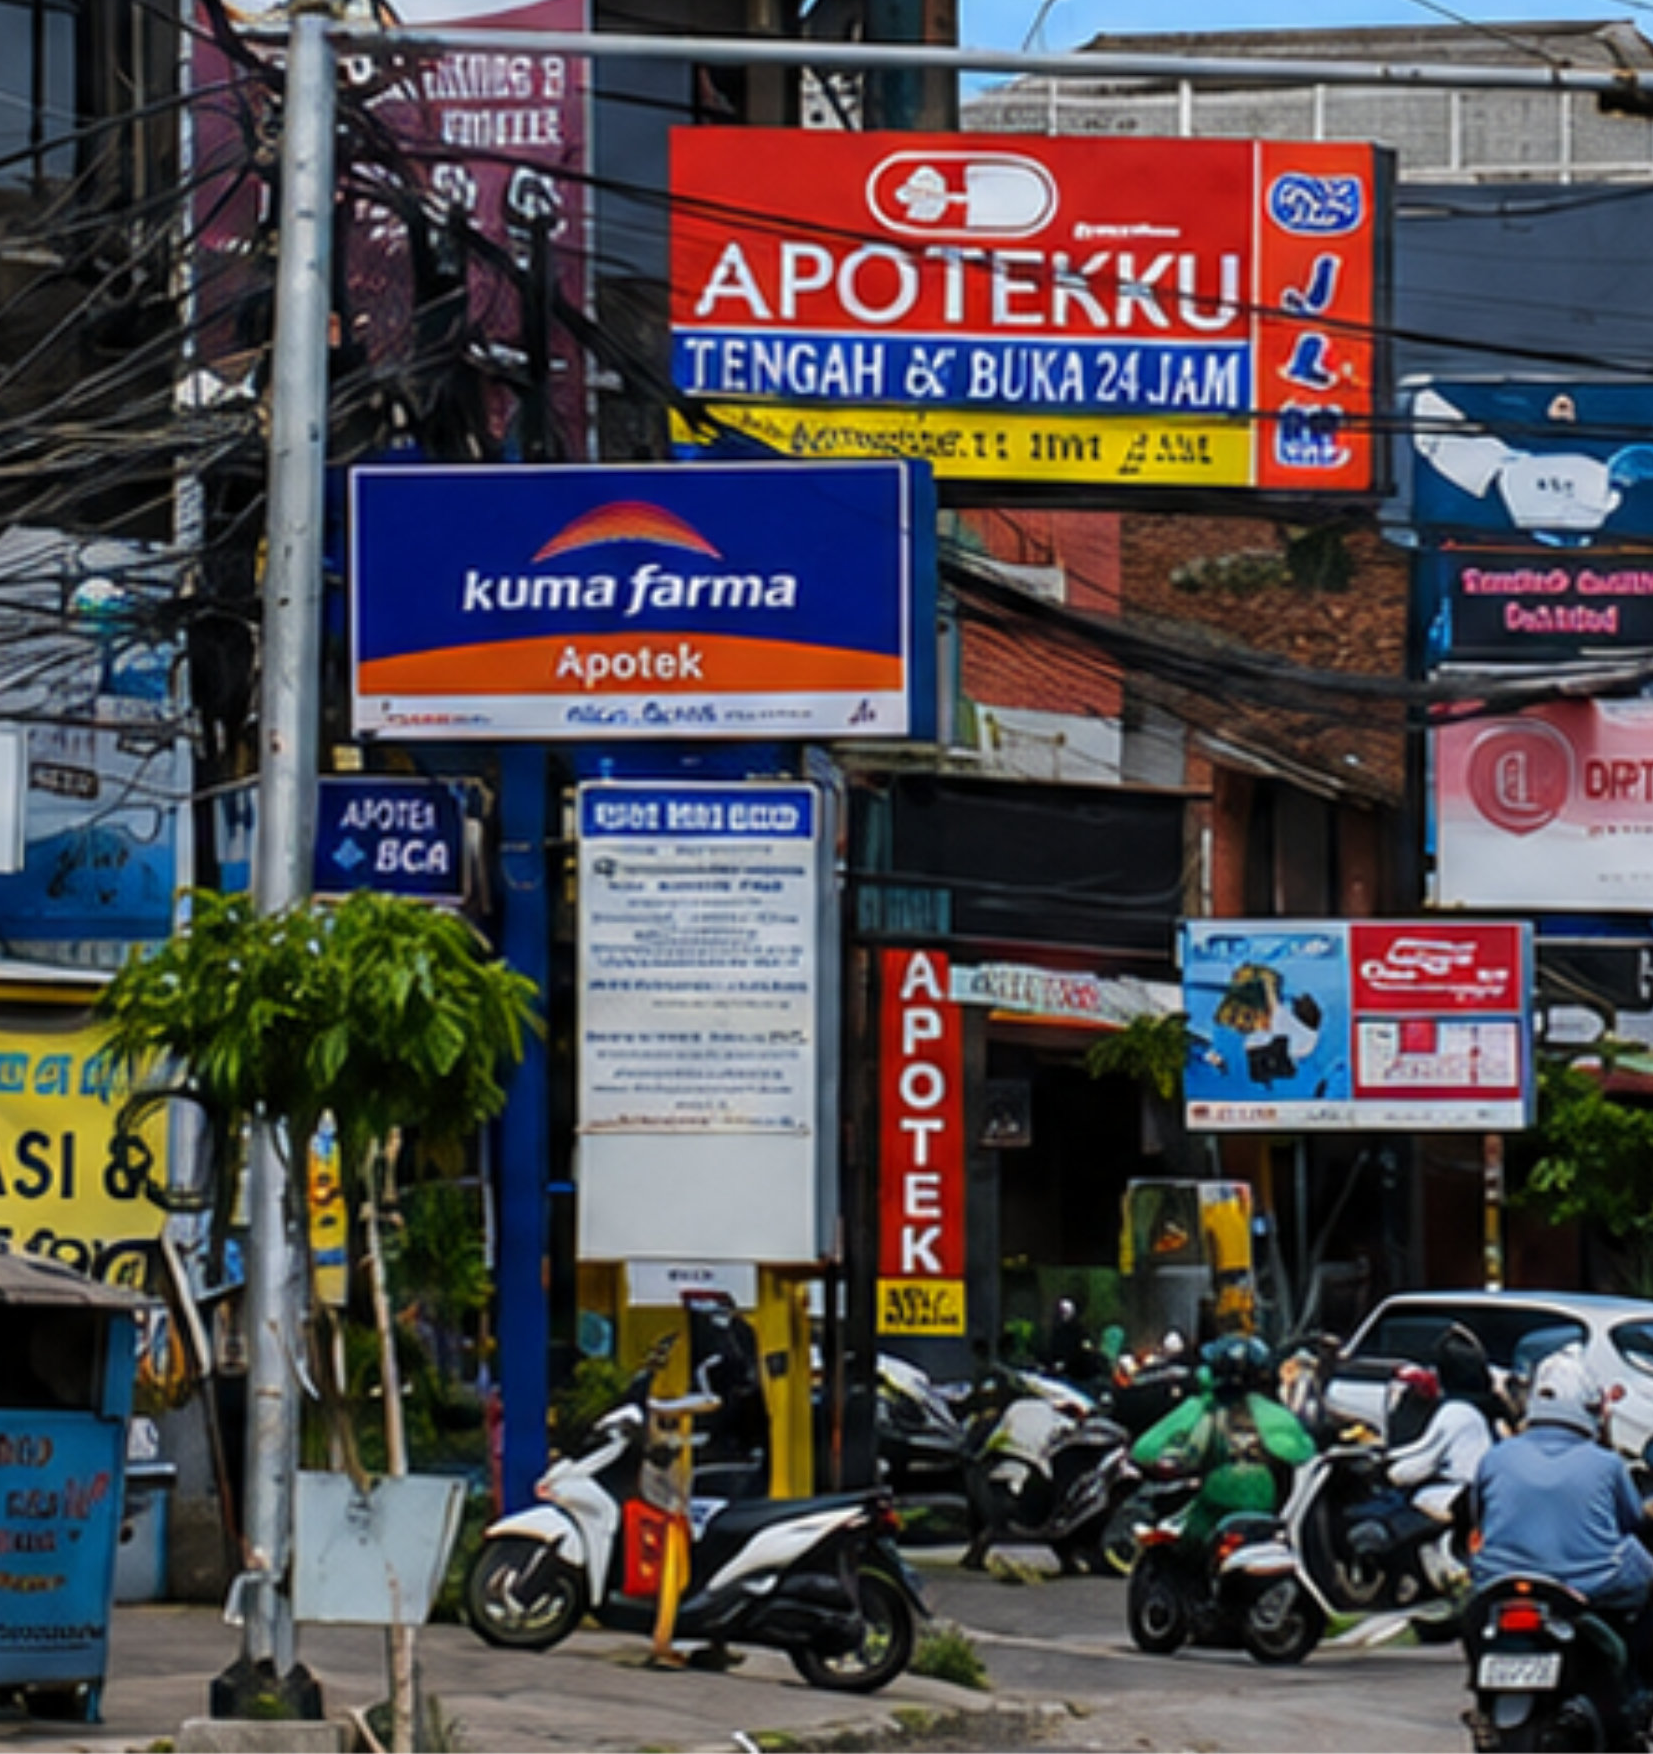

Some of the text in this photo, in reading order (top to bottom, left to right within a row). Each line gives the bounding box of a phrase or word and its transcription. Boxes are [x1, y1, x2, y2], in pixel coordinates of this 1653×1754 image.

[694, 242, 1239, 331] APOTEKKU
[685, 338, 1241, 408] TENGAH & BUKA 24 JAM
[462, 563, 797, 616] kuma farma
[556, 644, 703, 687] Apotek
[374, 839, 450, 874] BCA
[899, 950, 944, 1275] APOTEK
